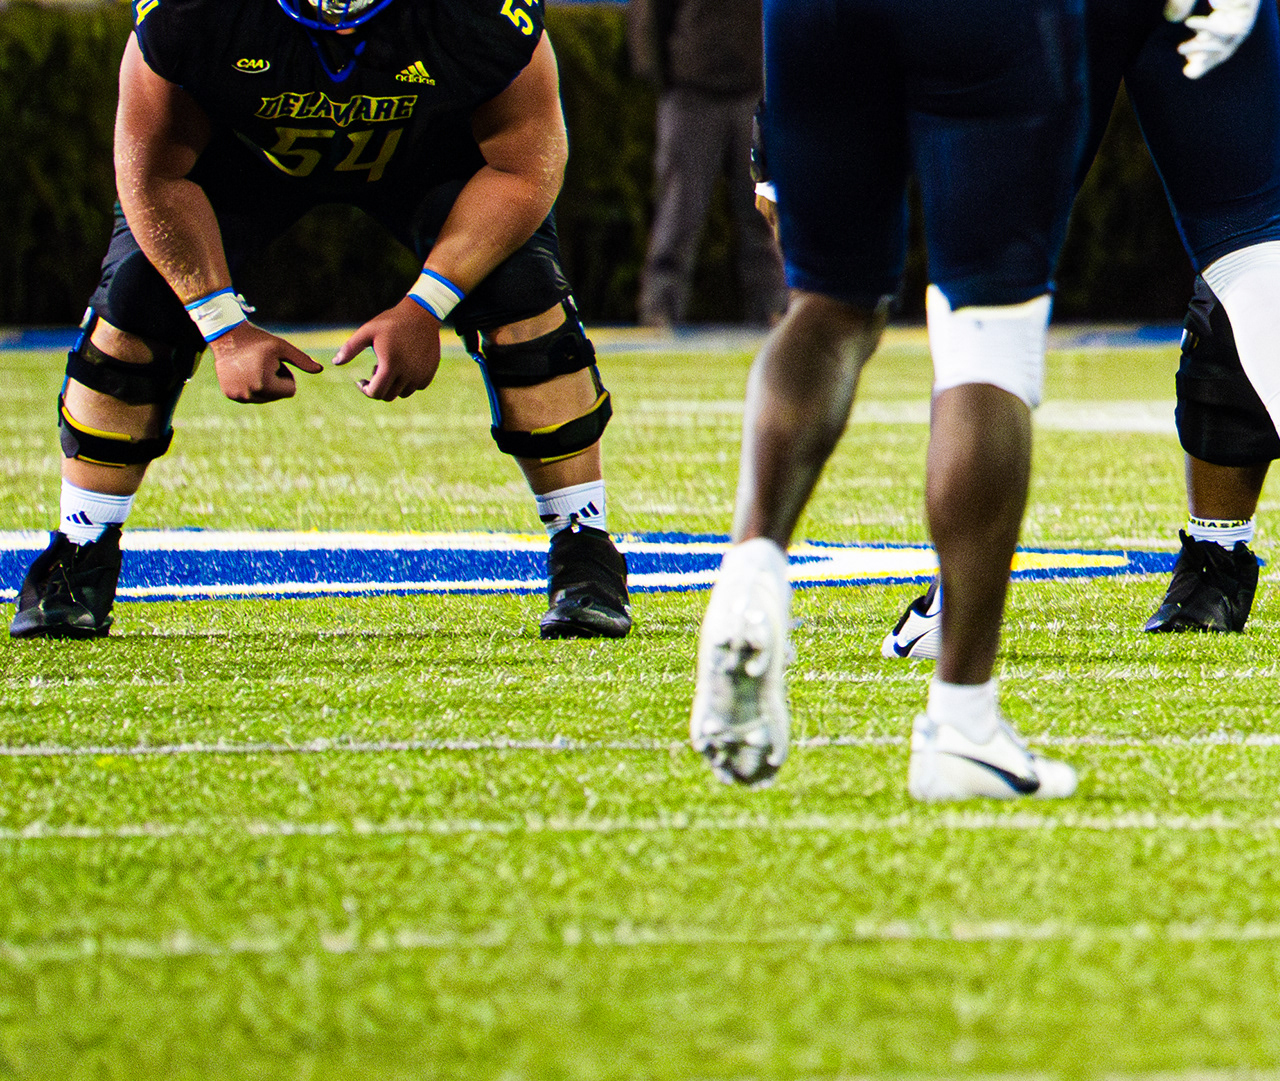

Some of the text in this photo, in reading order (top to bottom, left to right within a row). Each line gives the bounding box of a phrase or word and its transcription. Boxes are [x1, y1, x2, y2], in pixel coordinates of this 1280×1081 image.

[236, 57, 265, 70] CAA
[395, 73, 436, 87] adidas
[254, 91, 419, 128] DELAWARE
[262, 126, 404, 183] 54
